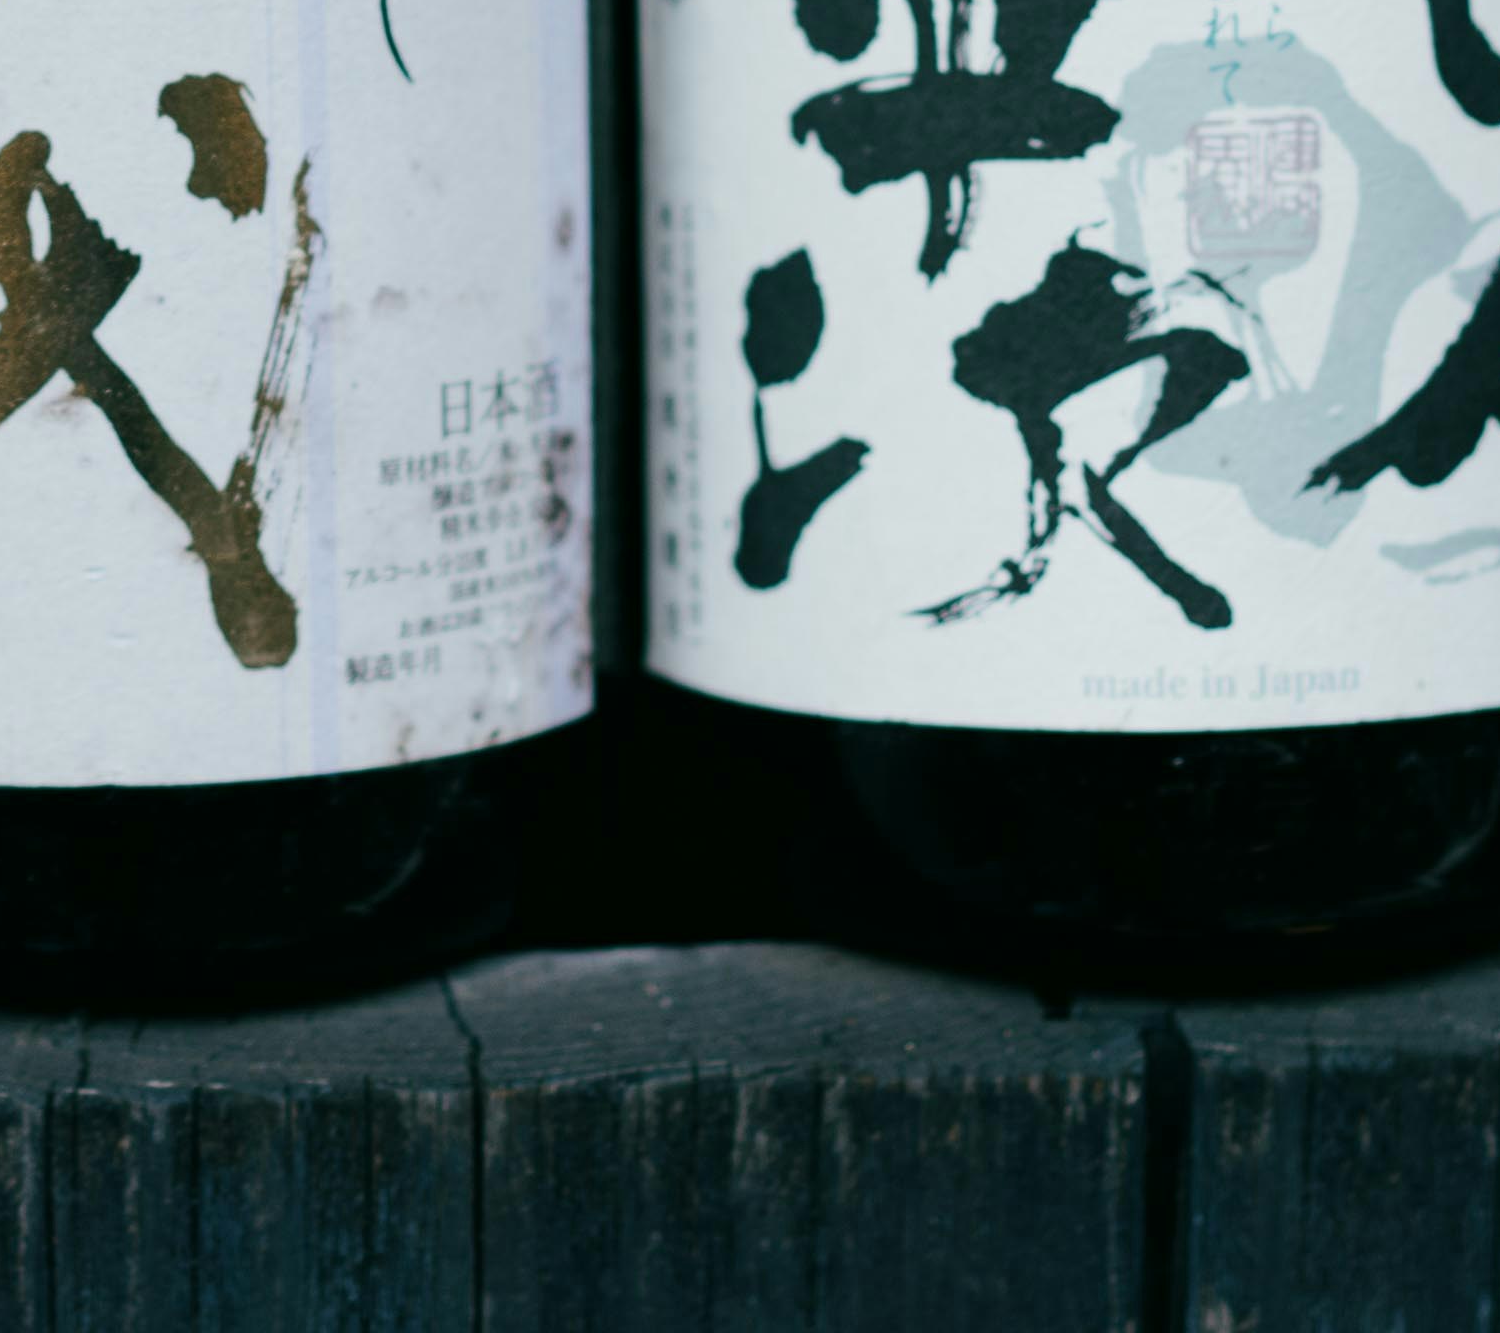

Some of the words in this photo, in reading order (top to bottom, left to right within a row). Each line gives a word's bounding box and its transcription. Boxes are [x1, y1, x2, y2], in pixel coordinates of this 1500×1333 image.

[439, 359, 559, 438] 日本酒
[1081, 666, 1188, 699] made
[1201, 665, 1236, 699] in
[1248, 663, 1361, 702] Japan
